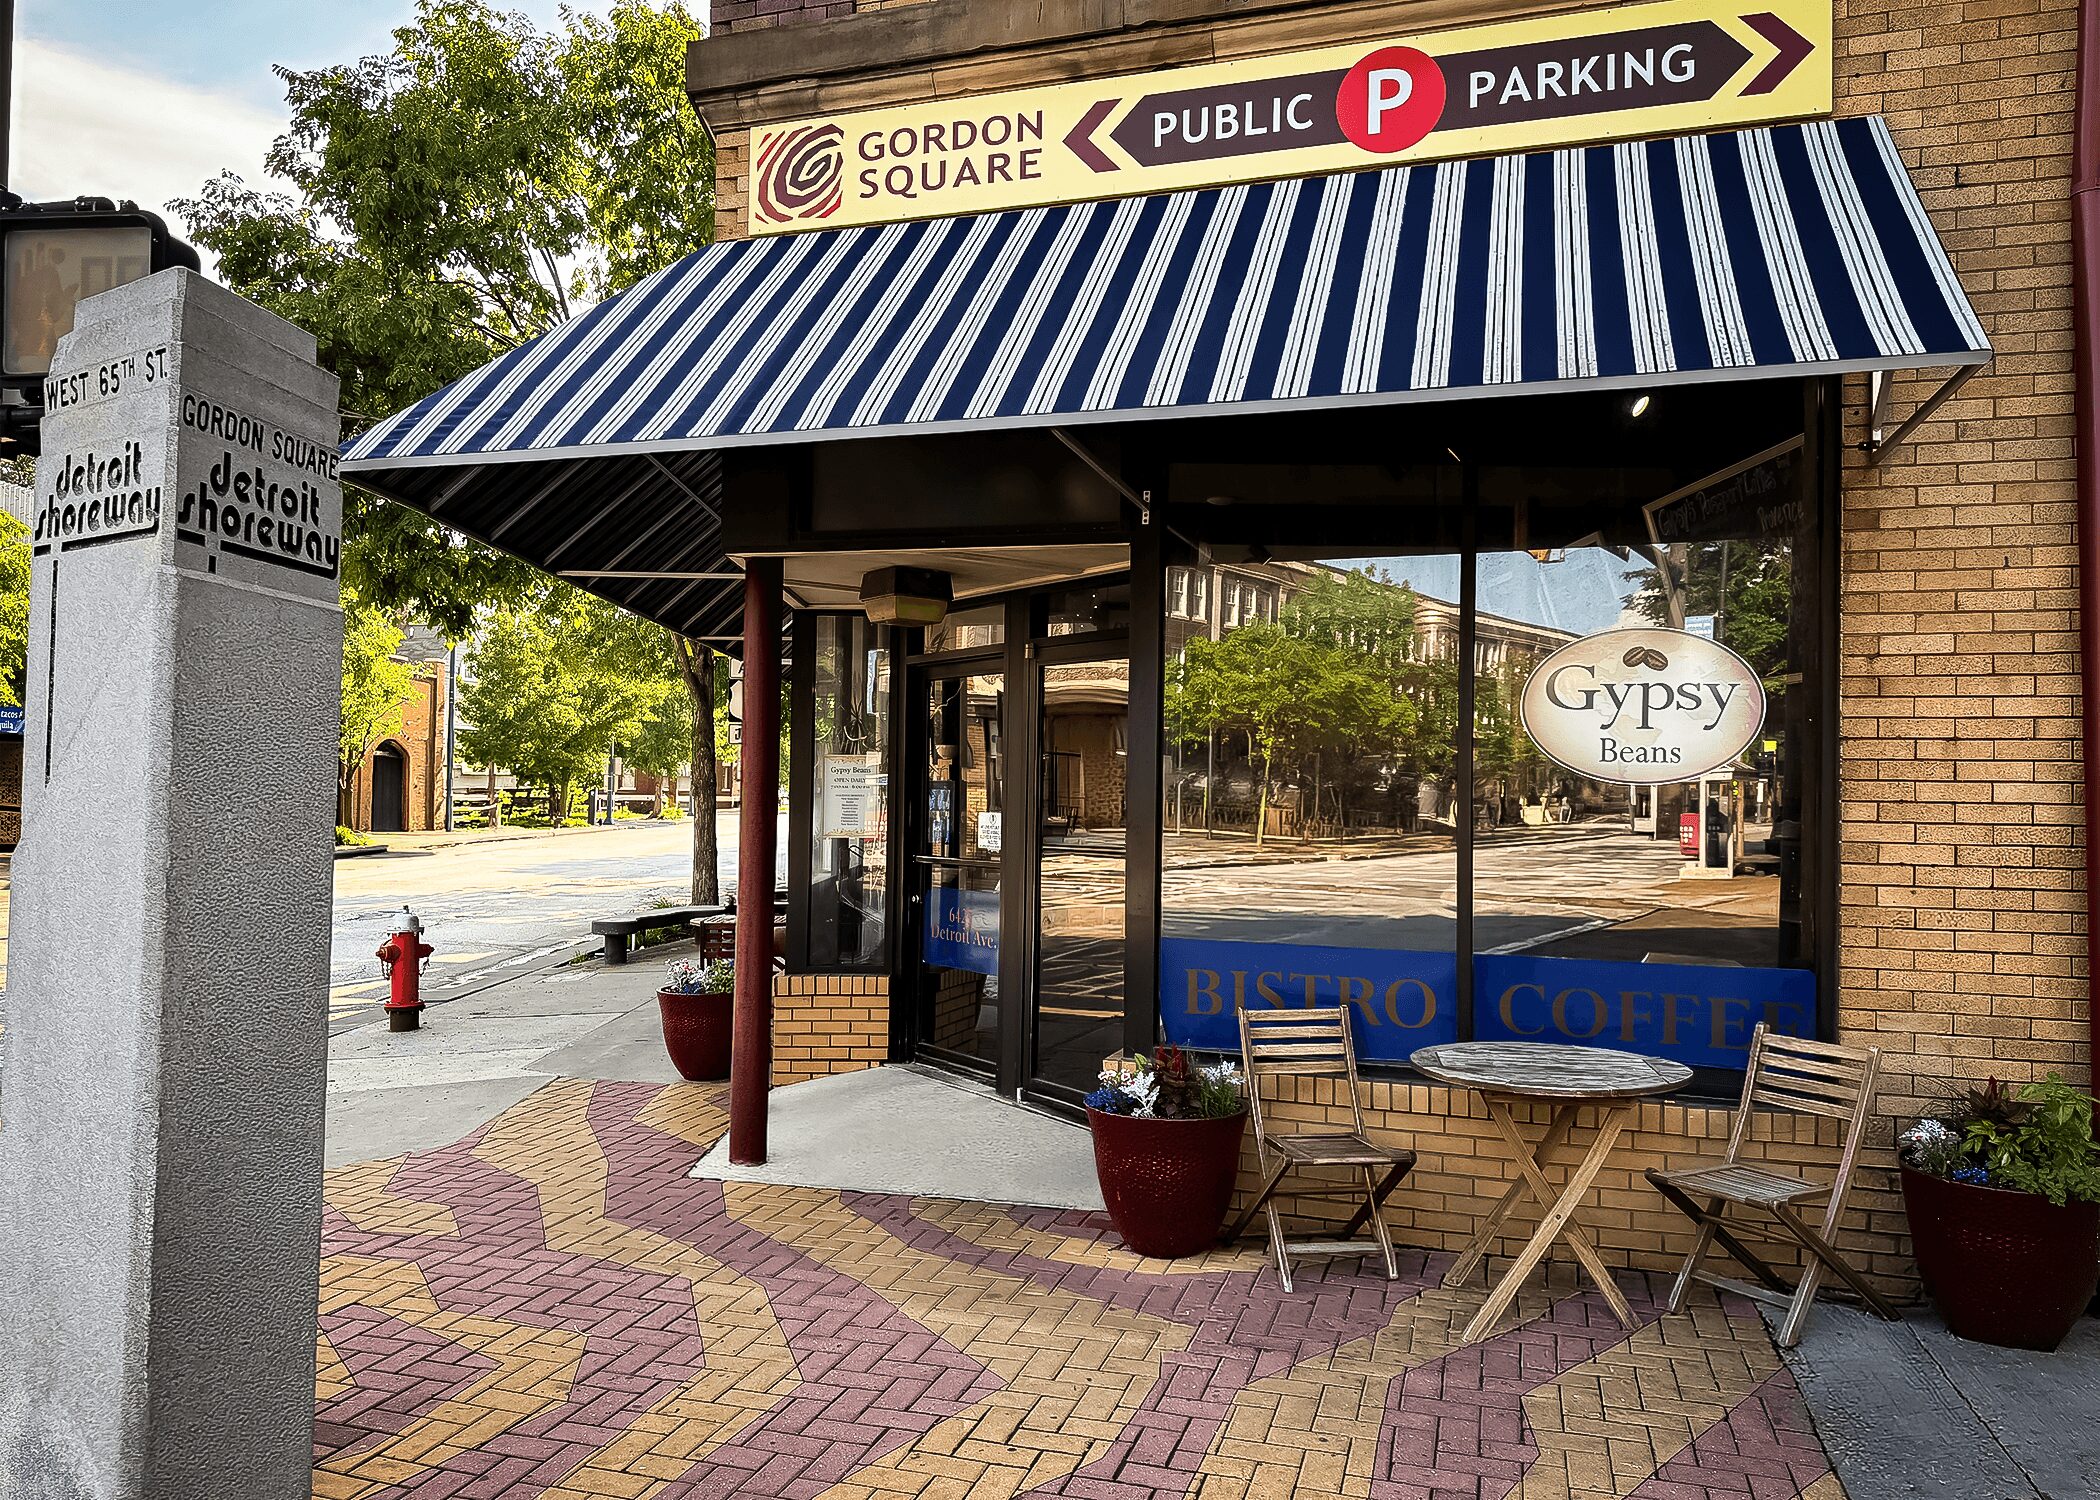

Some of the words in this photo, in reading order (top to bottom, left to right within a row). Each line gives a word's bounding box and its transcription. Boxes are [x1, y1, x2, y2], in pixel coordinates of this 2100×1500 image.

[1153, 93, 1313, 147] PUBLIC
[1367, 68, 1414, 135] P
[1468, 43, 1696, 108] PARKING
[858, 110, 1044, 162] GORDON
[859, 148, 1043, 200] SQUARE
[46, 372, 90, 412] WEST
[99, 361, 136, 397] 65TH
[145, 347, 169, 383] ST.
[182, 393, 264, 453] GORDON
[271, 431, 339, 482] SQUARE
[56, 441, 142, 501] detroit
[210, 451, 321, 529] detroit
[35, 485, 161, 541] shoreway
[177, 481, 340, 567] shoreway
[1545, 664, 1741, 731] Gypsy
[830, 766, 851, 775] Gypsy
[852, 766, 872, 774] Beans
[1599, 737, 1682, 764] Beans
[931, 924, 970, 945] Detroit
[972, 930, 998, 949] Ave.
[1185, 967, 1438, 1029] BISTRO
[1500, 983, 1804, 1050] COFFEE
